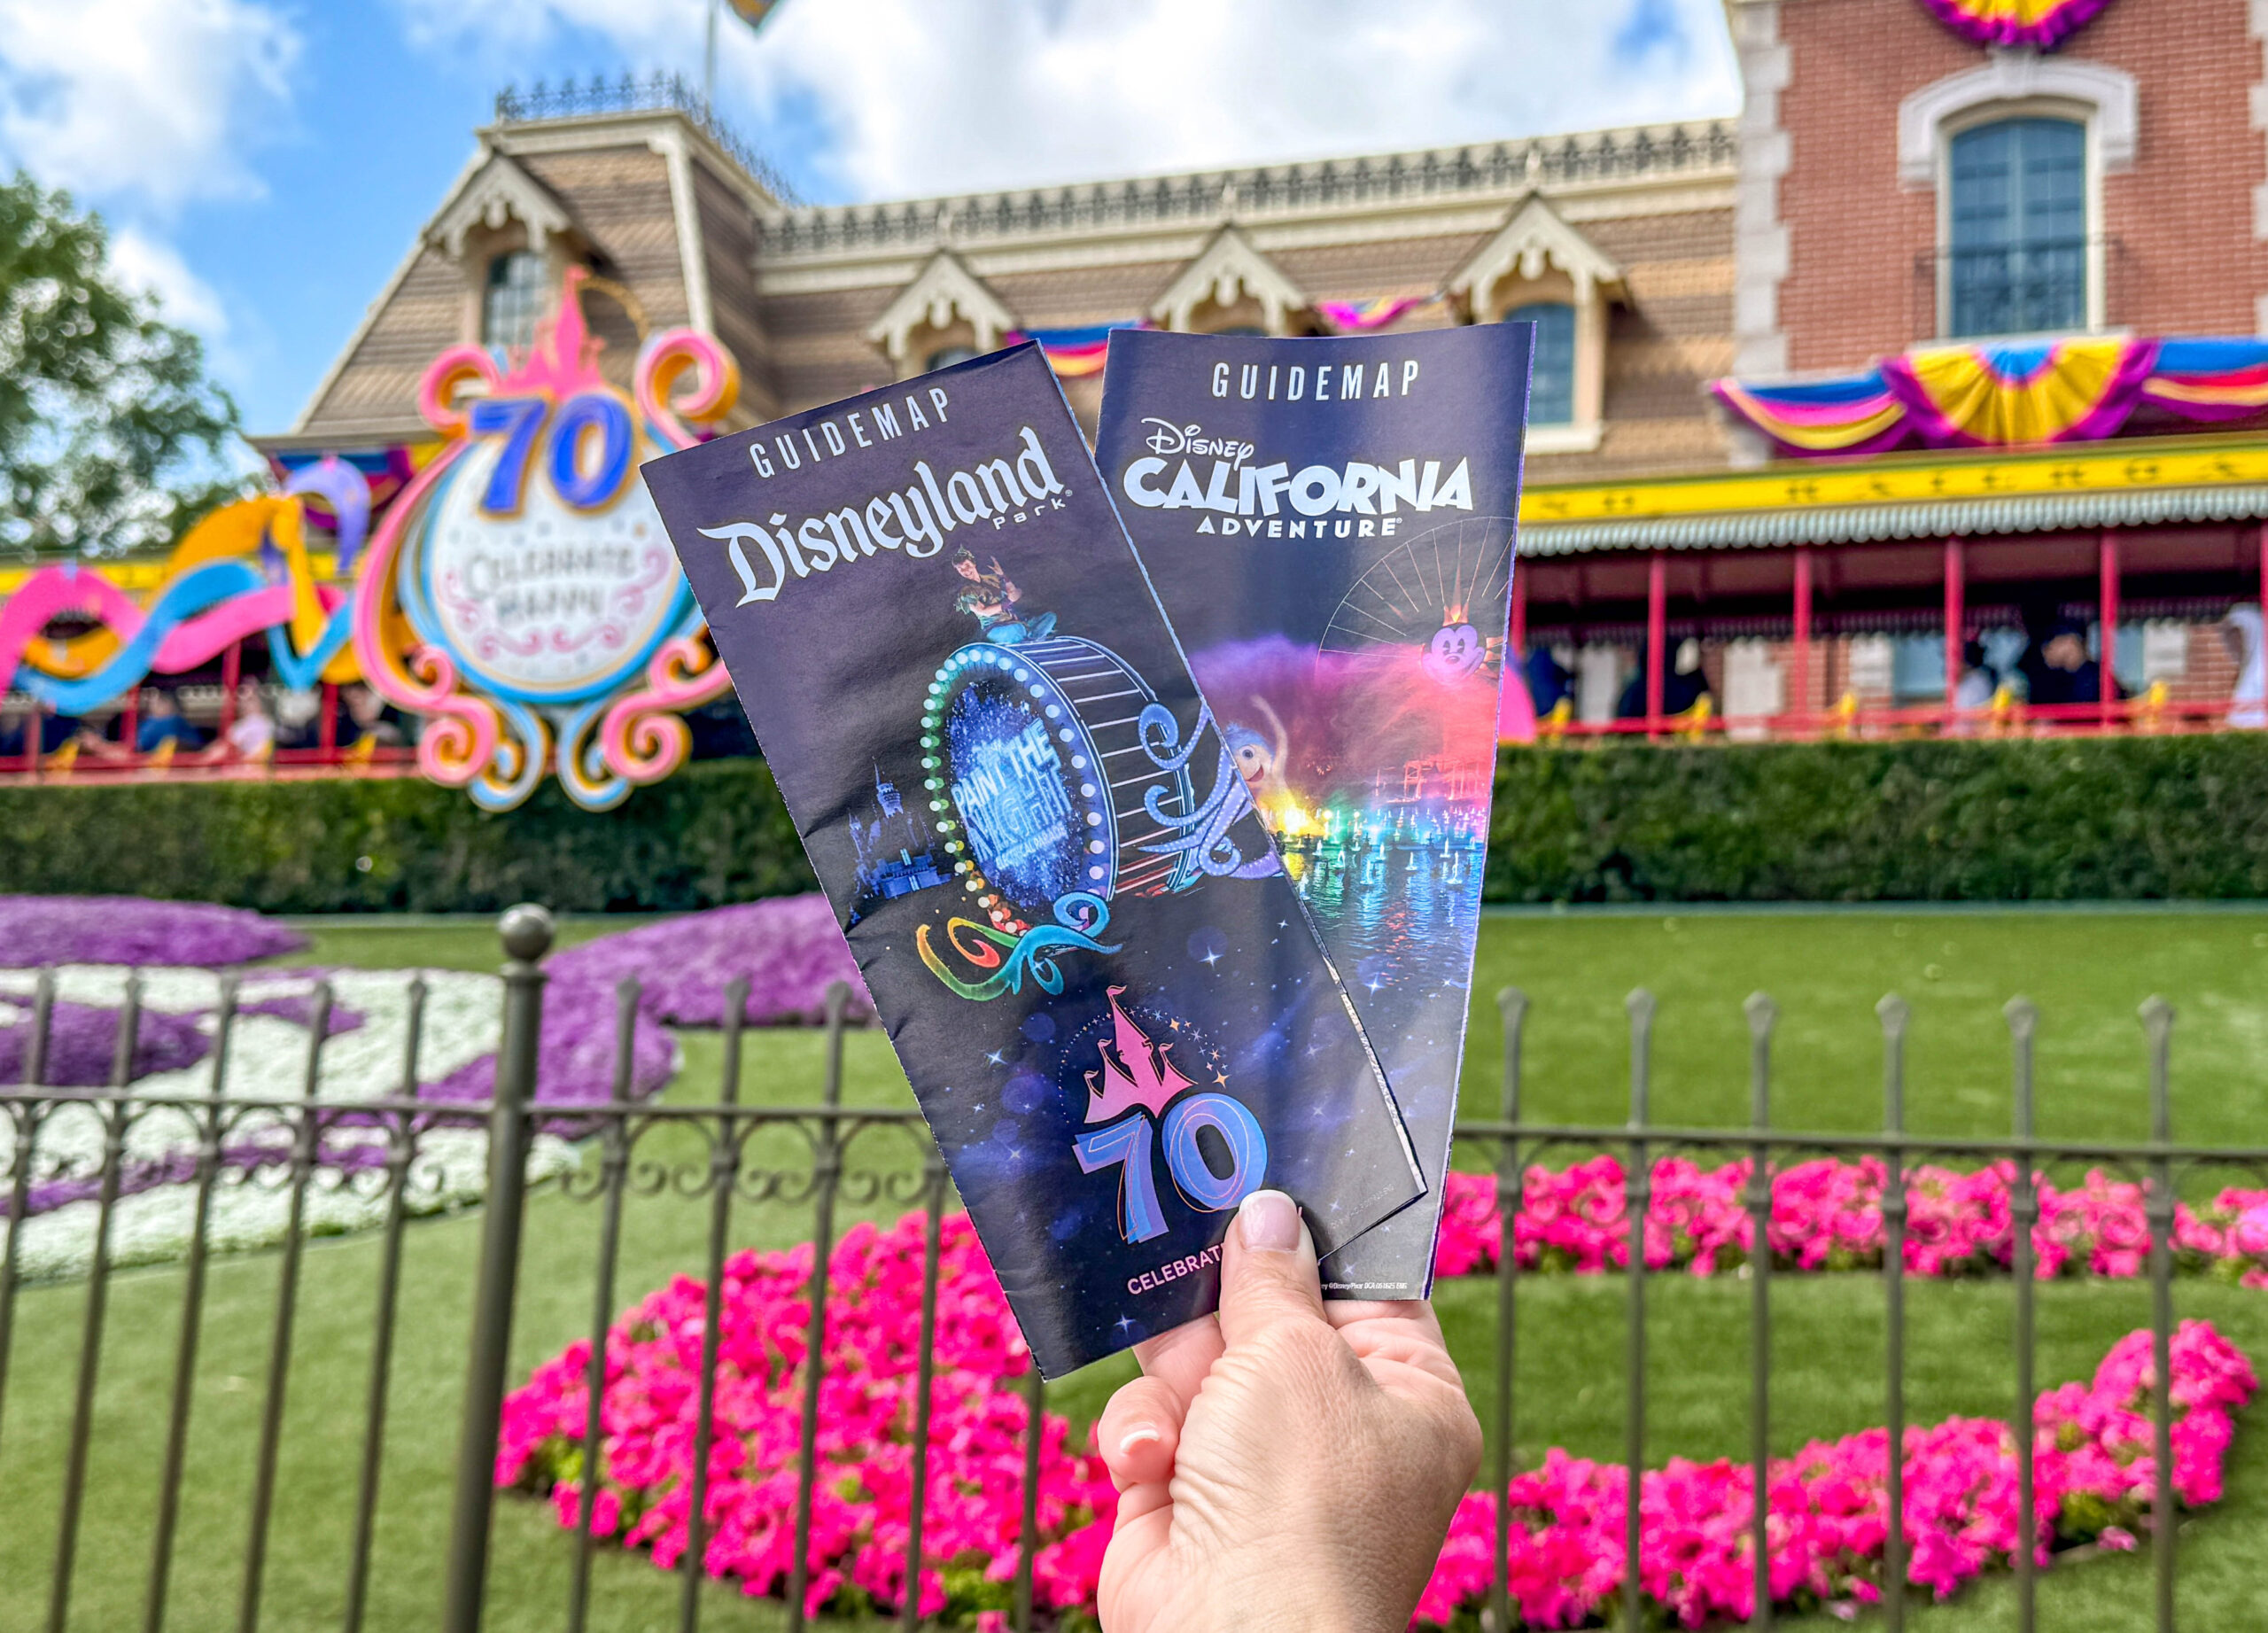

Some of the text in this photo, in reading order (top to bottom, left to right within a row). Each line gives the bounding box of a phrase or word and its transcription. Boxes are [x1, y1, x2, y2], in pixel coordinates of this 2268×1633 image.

[1212, 360, 1418, 401] GUIDEMAP
[468, 393, 636, 514] 70
[750, 387, 950, 478] GUIDEMAP
[1141, 417, 1254, 471] Disney
[697, 426, 1065, 608] Disneyland
[1123, 456, 1473, 517] CALIFORNIA
[1196, 516, 1397, 539] ADVENTURE
[951, 755, 1007, 818] PAINT
[1005, 718, 1052, 779] THE
[967, 746, 1072, 863] NIGHT
[1072, 1093, 1268, 1246] 70
[1127, 1242, 1223, 1295] CELEBRAT
